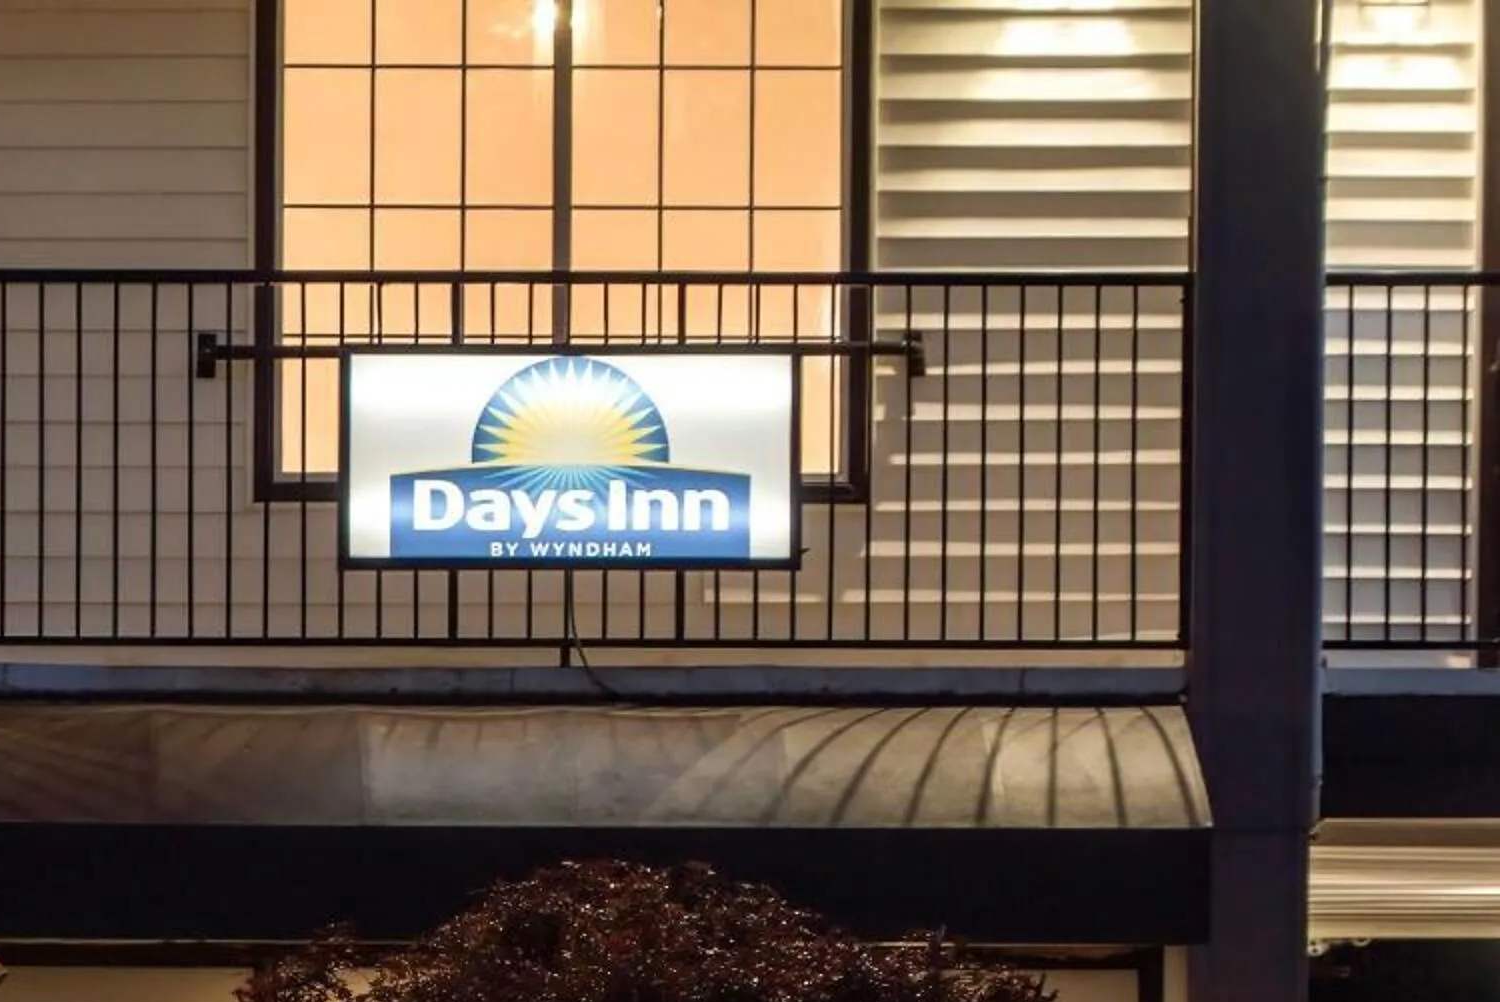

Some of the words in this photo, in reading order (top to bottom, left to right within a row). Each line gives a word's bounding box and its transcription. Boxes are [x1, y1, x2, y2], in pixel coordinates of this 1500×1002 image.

[412, 479, 595, 538] Days
[607, 479, 731, 532] Inn
[490, 541, 518, 557] BY
[529, 541, 653, 557] WYNDHAM
